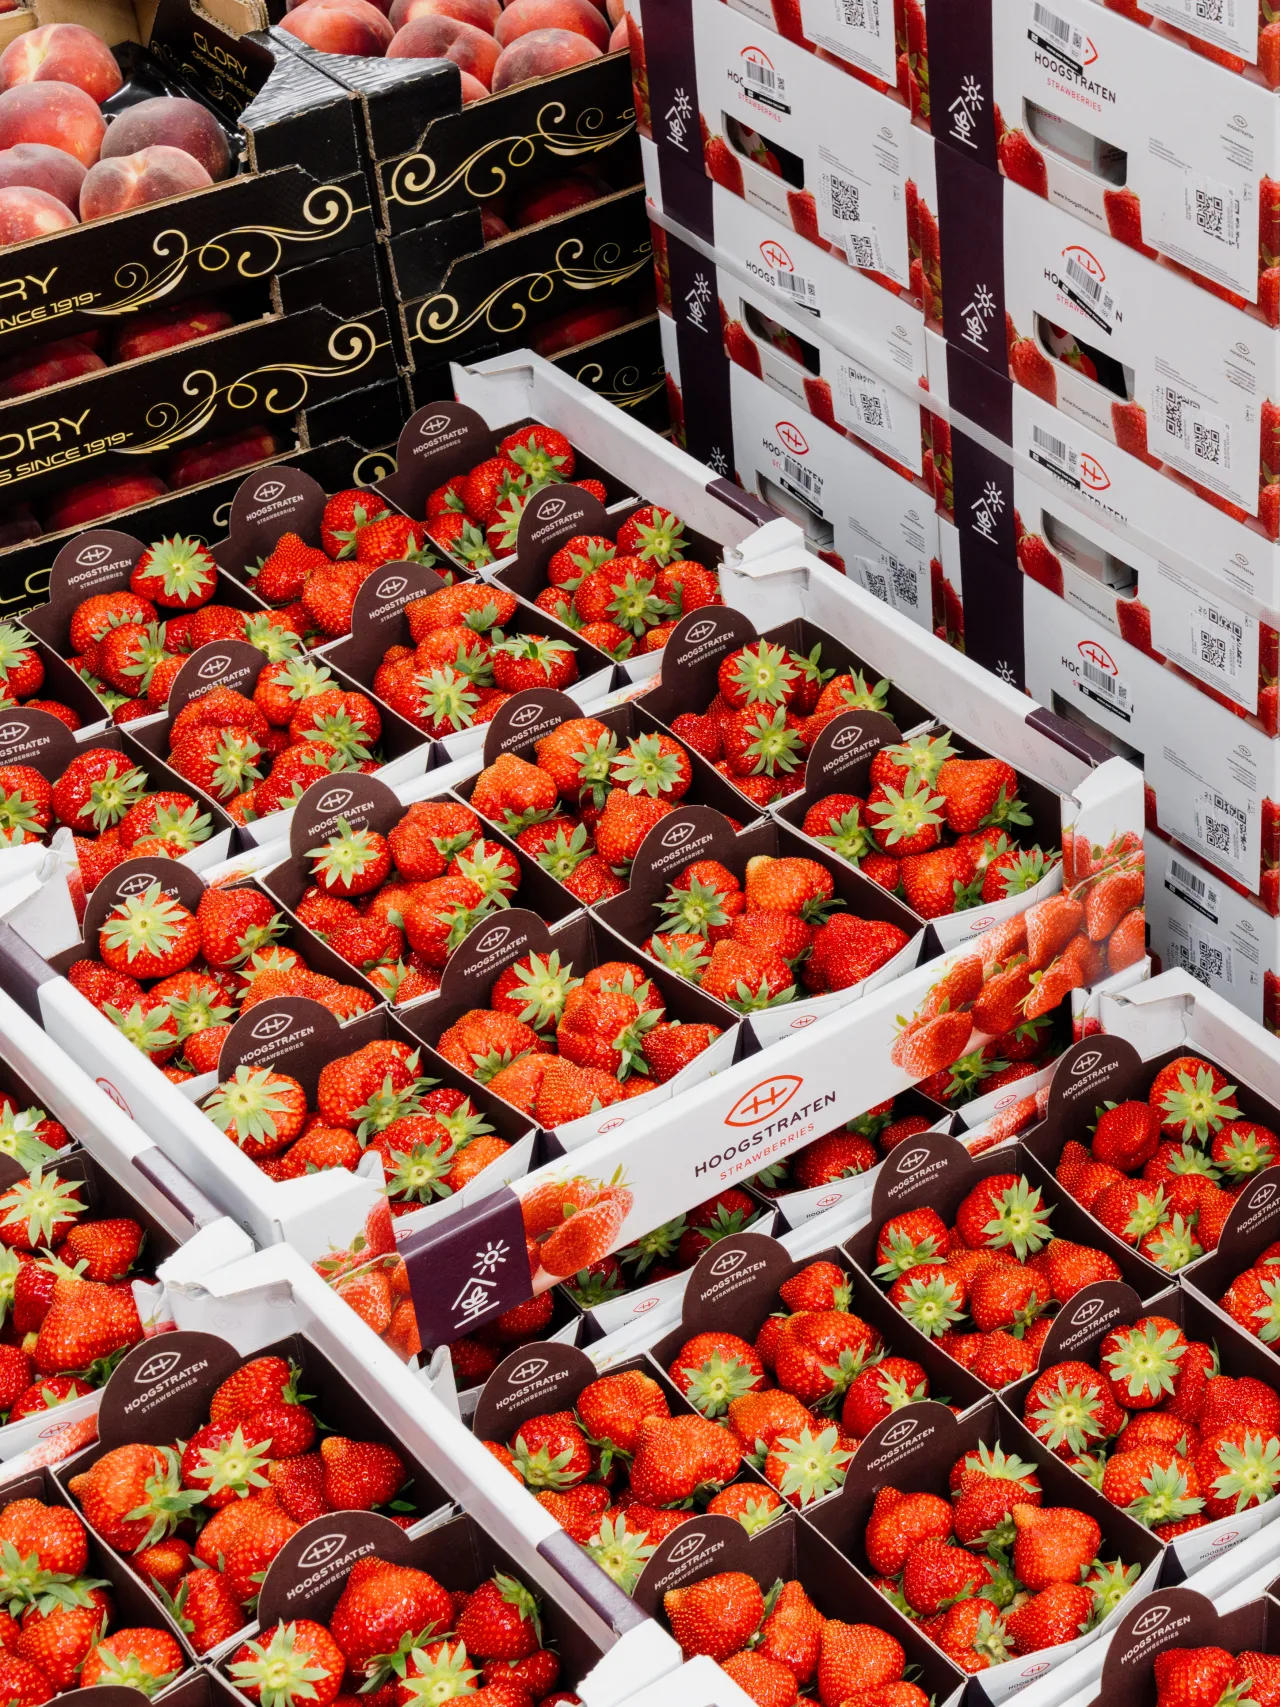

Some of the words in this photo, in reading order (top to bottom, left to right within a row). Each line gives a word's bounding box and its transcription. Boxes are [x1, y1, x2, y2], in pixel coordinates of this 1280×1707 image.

[193, 31, 248, 80] GLORY
[1034, 51, 1117, 104] HOOGSTRATEN
[1046, 77, 1102, 113] STRAWBERRIES
[0, 305, 48, 331] NCE
[0, 408, 91, 461] ORY
[412, 426, 469, 455] HOOGSTRATEN
[16, 445, 82, 475] SINCE
[246, 494, 304, 522] HOOGSTRATEN
[531, 510, 584, 541] HOOGSTRATEN
[68, 558, 133, 585] HOOGSTRATEN
[368, 588, 427, 621] HOOGSTRATEN
[677, 630, 734, 665] HOOGSTRATEN
[188, 665, 251, 700] HOOGSTRATEN
[0, 736, 50, 757] GSTRATEN
[501, 715, 562, 749] HOOGSTRATEN
[822, 736, 880, 773] HOOGSTRATEN
[650, 832, 713, 871] HOOGSTRATEN
[463, 933, 528, 976] HOOGSTRATEN
[240, 1026, 314, 1065] HOOGSTRATEN
[1062, 1061, 1119, 1099] HOOGSTRATEN
[694, 1090, 837, 1178] HOOGSTRATEN
[719, 1122, 816, 1181] STRAWBERRIES
[887, 1158, 949, 1198] HOOGSTRATEN
[701, 1260, 767, 1301] HOOGSTRATEN
[1059, 1307, 1121, 1351] HOOGSTRATEN
[124, 1359, 208, 1414] HOOGSTRATEN
[495, 1370, 569, 1410] HOOGSTRATEN
[867, 1426, 935, 1471] HOOGSTRATEN
[286, 1541, 376, 1600] HOOGSTRATEN
[654, 1540, 725, 1591] HOOGSTRATEN
[1121, 1614, 1191, 1665] HOOGSTRATEN
